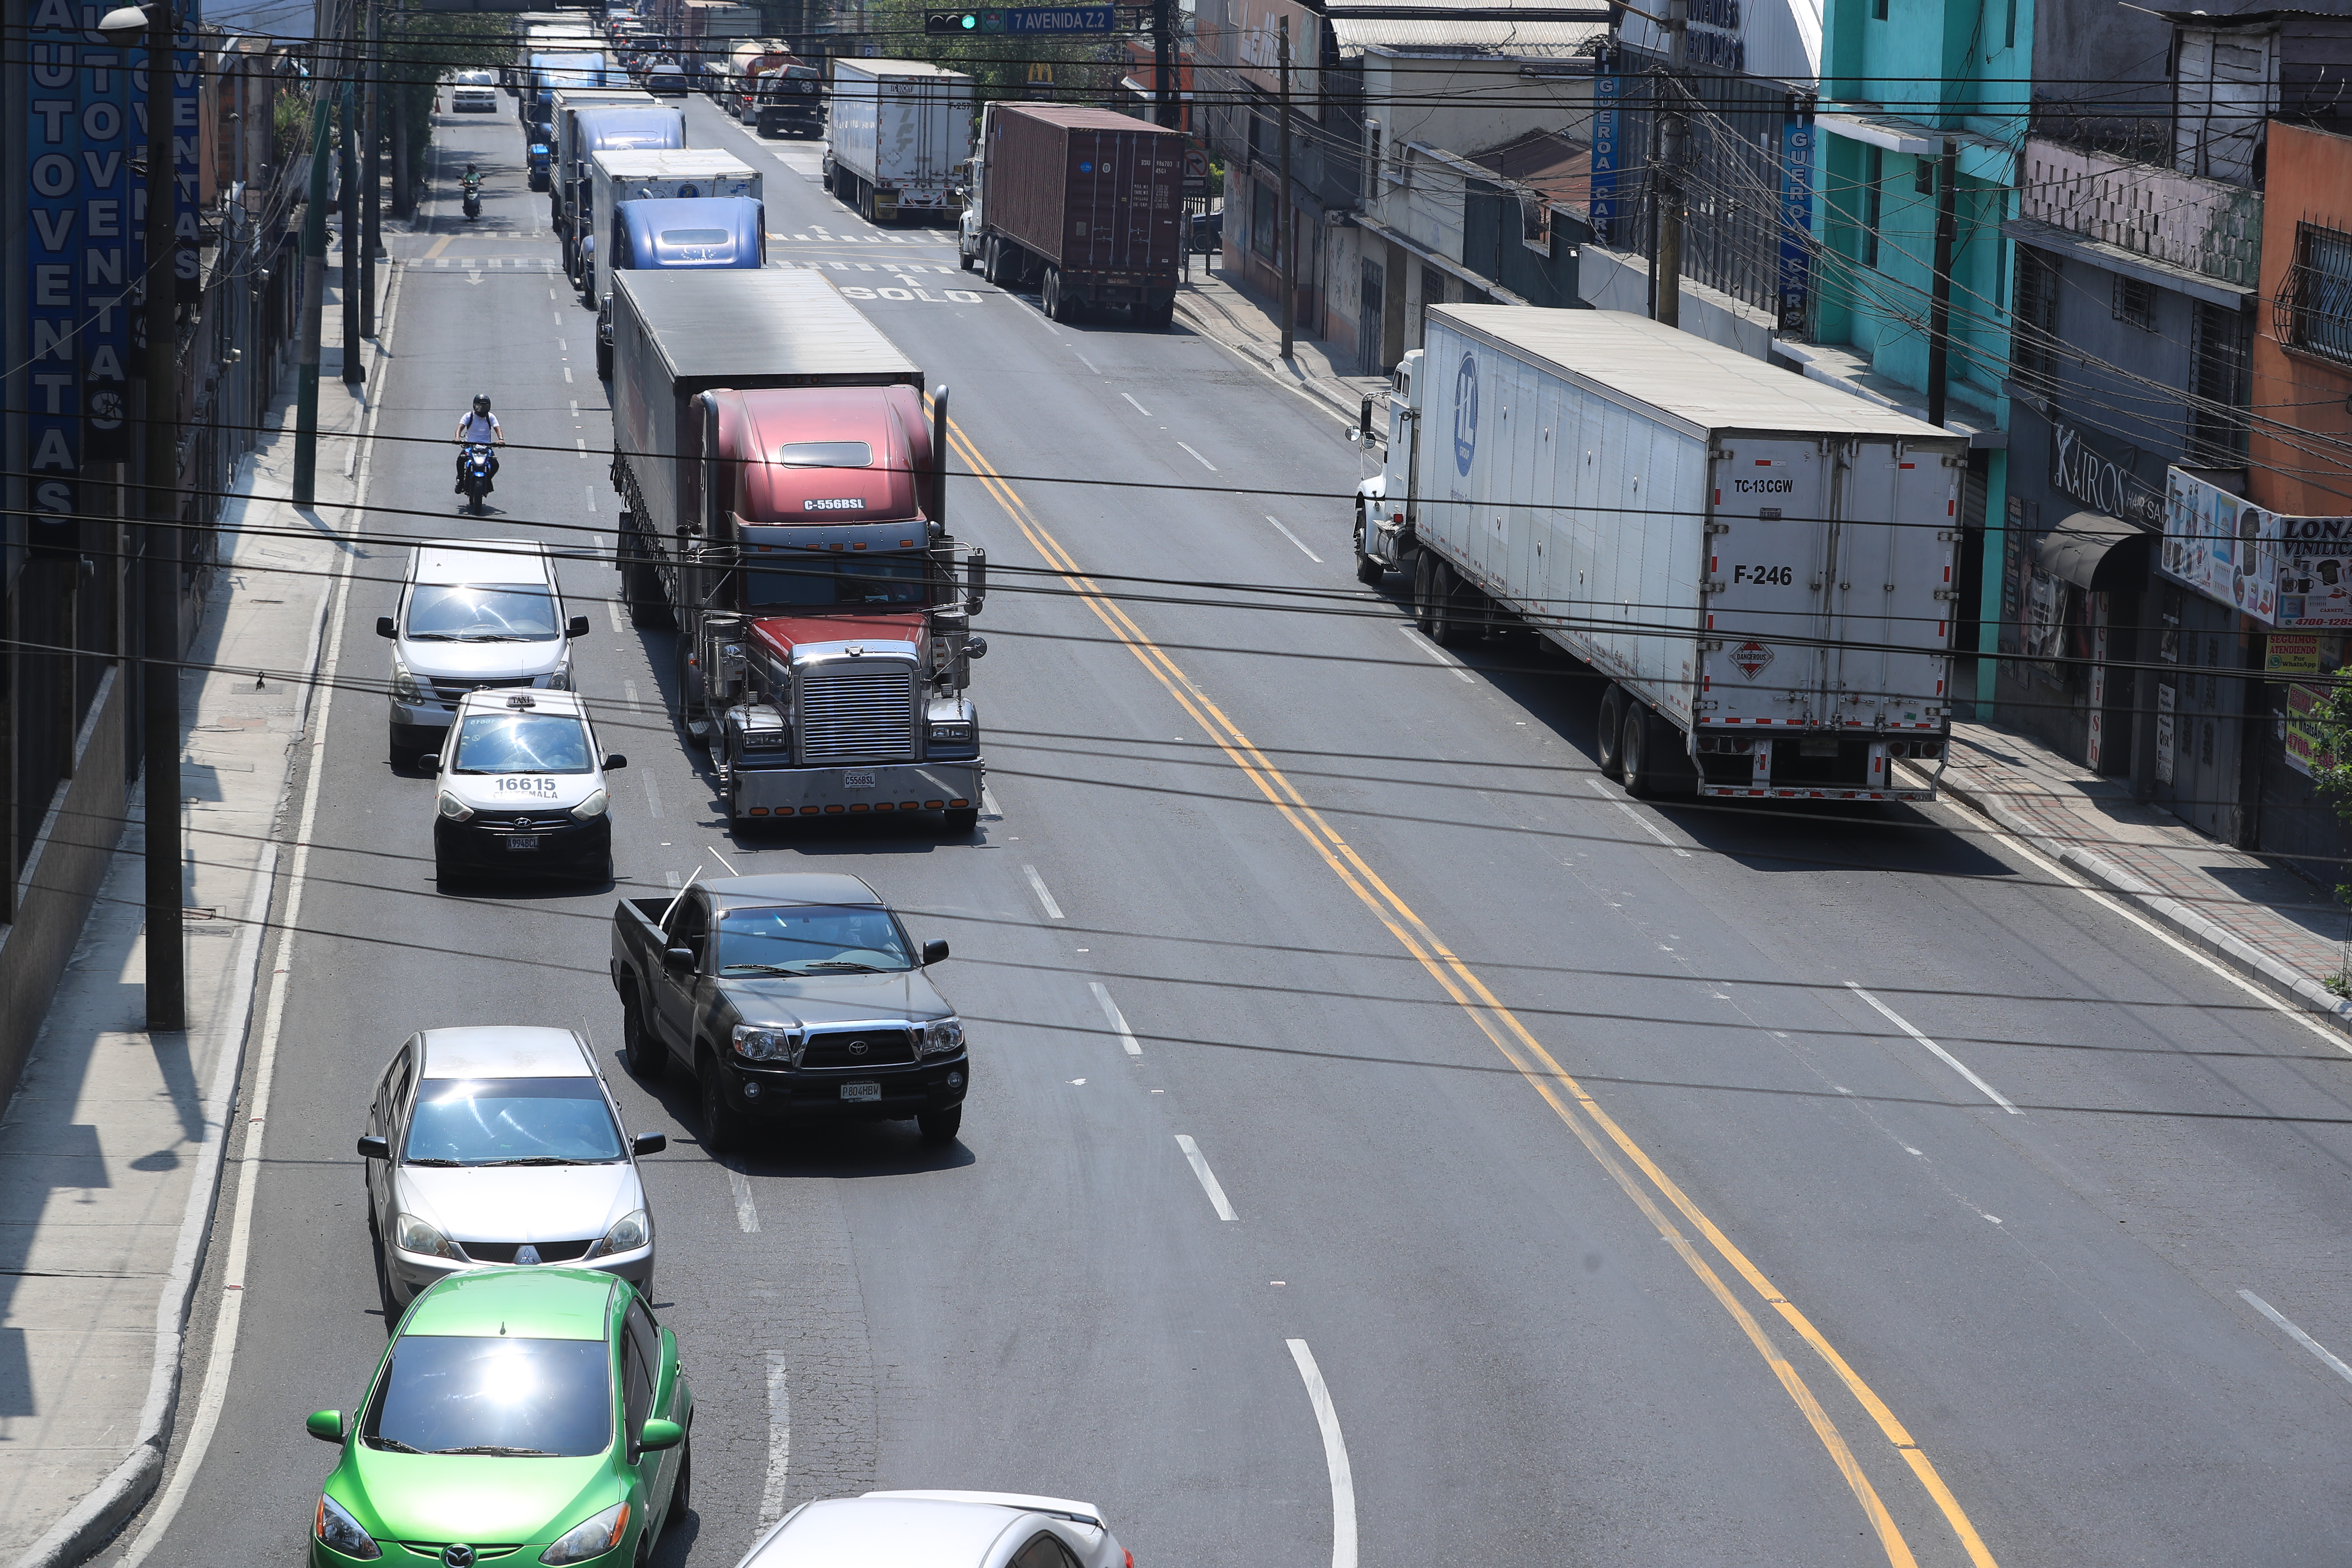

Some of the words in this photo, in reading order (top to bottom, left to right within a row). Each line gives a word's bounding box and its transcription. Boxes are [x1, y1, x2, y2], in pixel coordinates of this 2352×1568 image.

[1015, 13, 1022, 29] 7
[1026, 12, 1083, 29] AVENIDA
[1086, 12, 1104, 28] Z.2
[1594, 188, 1609, 245] CARS
[31, 0, 75, 524] AUTOVENTAS
[839, 286, 983, 303] SOLO
[1787, 258, 1803, 325] CARS
[1459, 446, 1470, 460] GROUP
[2054, 423, 2127, 518] KAIROS
[2127, 490, 2144, 516] HAIR
[804, 499, 864, 510] C-556BSL
[2283, 541, 2352, 556] VINILIC
[1734, 565, 1792, 586] F-246
[2270, 634, 2317, 644] SEGUIMOS
[2269, 645, 2316, 655] ATENDIENDO
[2289, 710, 2297, 729] Por
[495, 778, 556, 791] 16615
[845, 776, 875, 785] C556BSL
[508, 839, 539, 848] A994BCL
[842, 1085, 879, 1096] P804HBW
